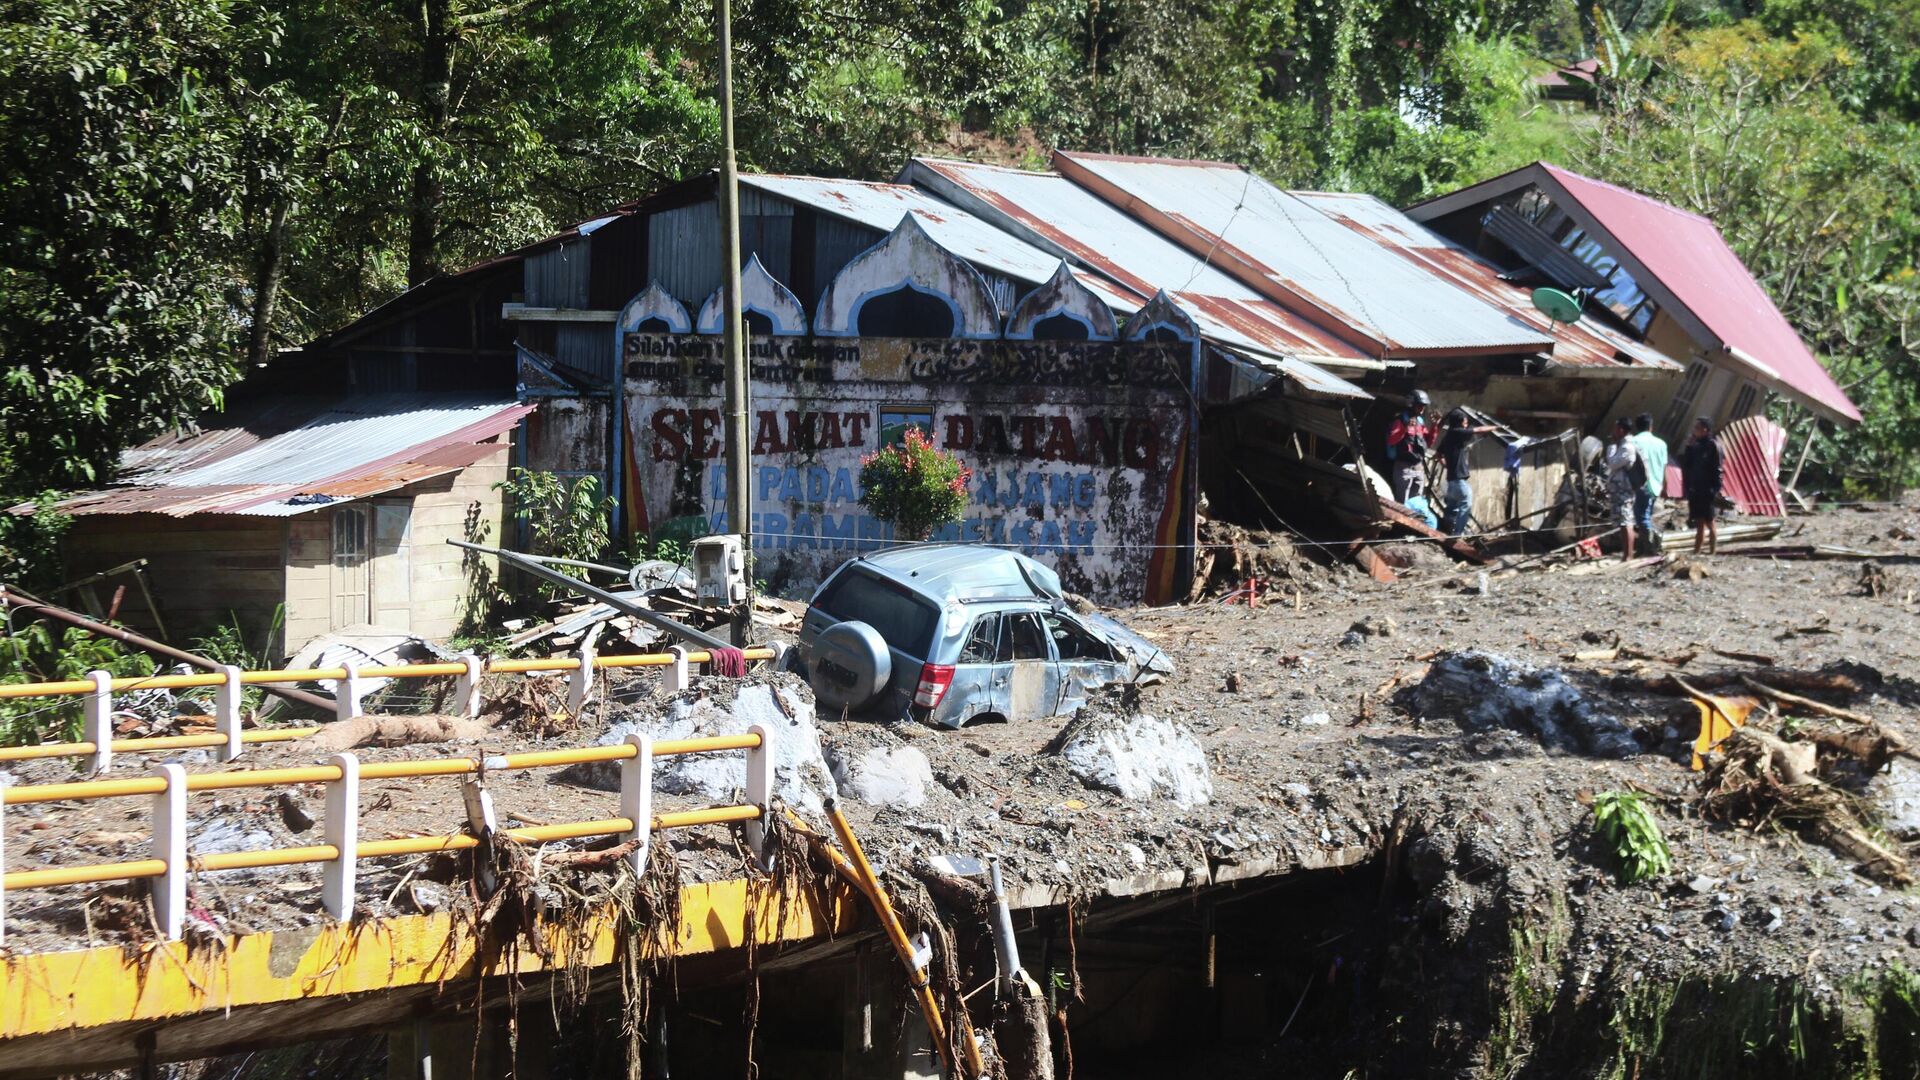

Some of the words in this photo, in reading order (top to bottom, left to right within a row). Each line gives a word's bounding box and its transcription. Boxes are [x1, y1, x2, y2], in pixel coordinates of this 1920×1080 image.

[627, 337, 714, 357] Silahkan
[651, 409, 871, 463] SEAMAT
[942, 415, 1160, 470] DATANG
[759, 466, 865, 504] PADA
[972, 470, 1096, 509] NJANG
